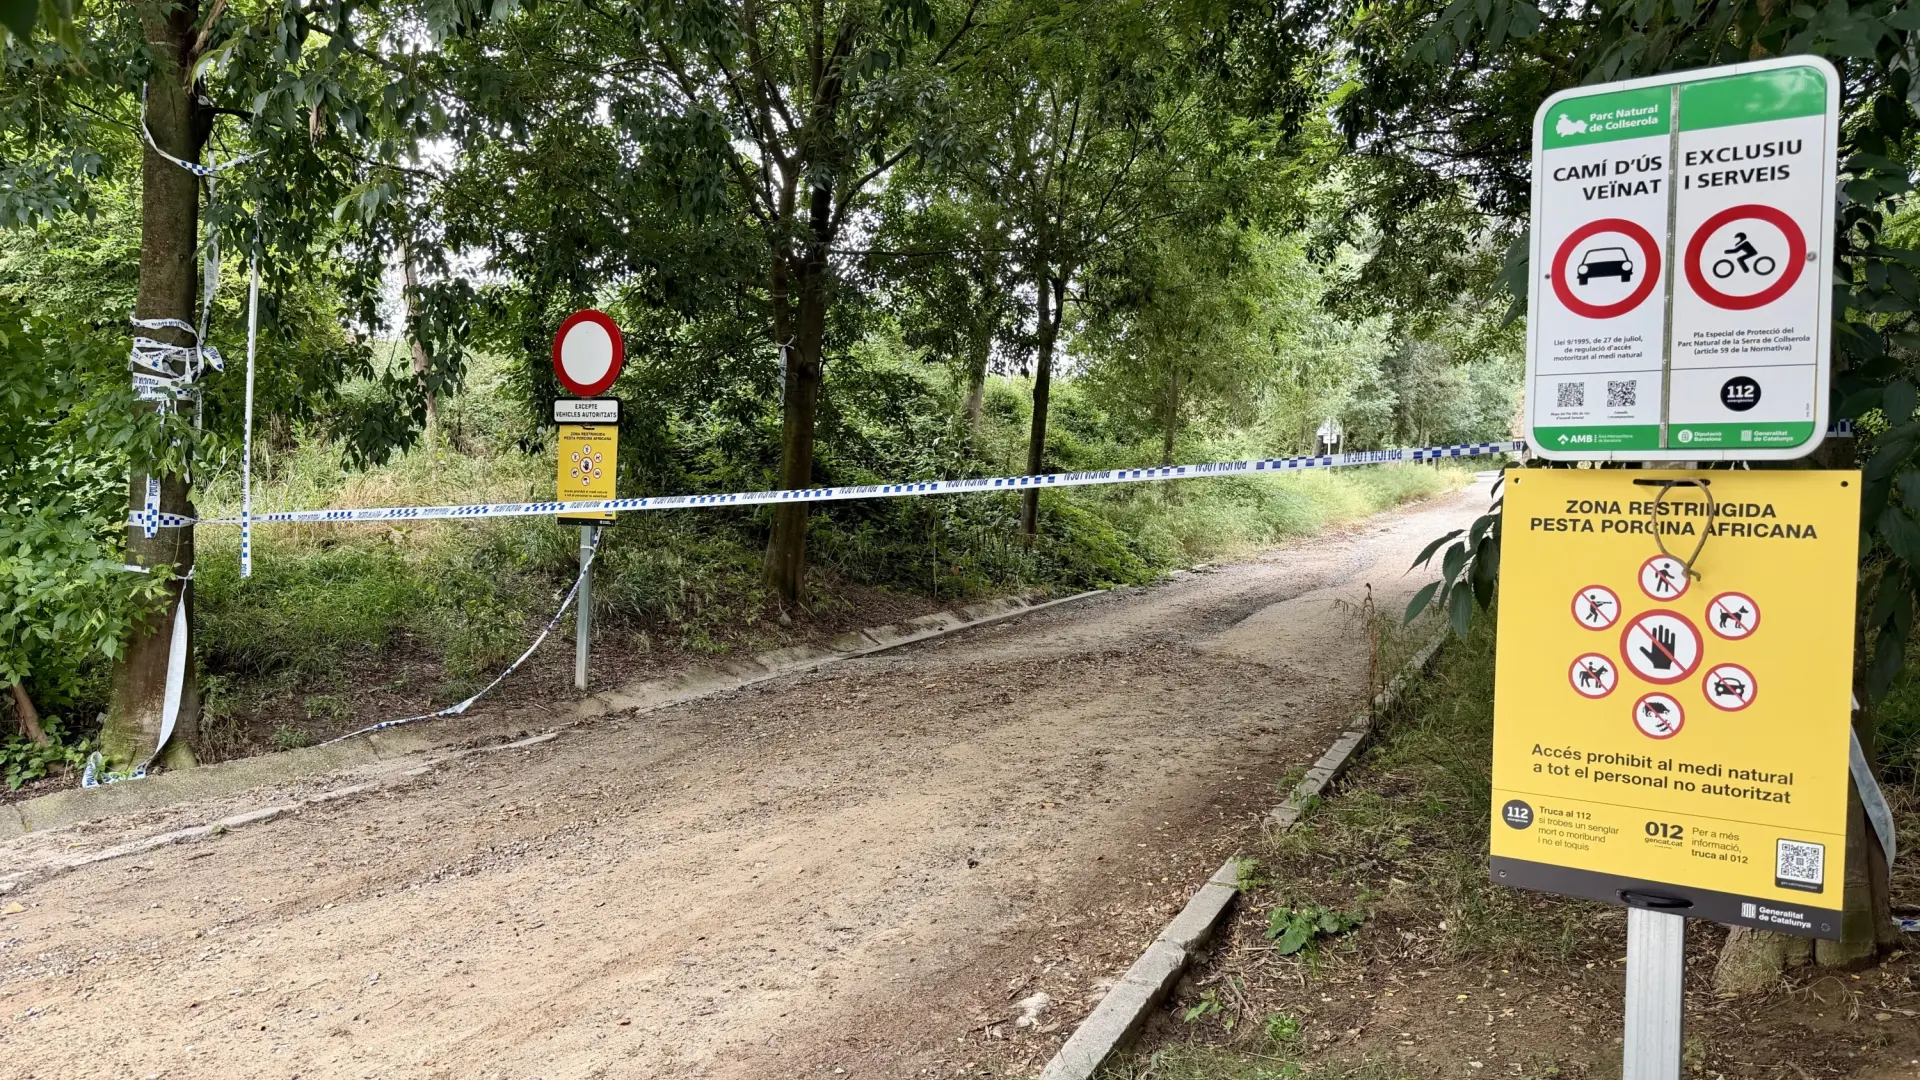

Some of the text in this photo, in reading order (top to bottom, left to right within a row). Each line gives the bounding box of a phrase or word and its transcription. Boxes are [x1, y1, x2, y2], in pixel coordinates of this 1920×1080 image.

[1590, 104, 1658, 121] Parc Natural
[1589, 116, 1658, 132] de Collserola
[1553, 139, 1802, 181] CAMÍ D'ÚS EXCLUSIU
[1583, 164, 1790, 200] VEÏNAT I SERVEIS
[1622, 335, 1643, 343] juliol,
[1706, 330, 1734, 339] Especial
[1747, 328, 1780, 336] Protecció
[1774, 335, 1810, 343] Collserola
[1574, 345, 1605, 353] regulació
[1750, 344, 1792, 353] Normativa)
[1727, 385, 1754, 399] 112
[1570, 434, 1593, 443] AMB
[1565, 499, 1776, 518] ZONA RESTRINGIDA
[1530, 518, 1818, 539] PESTA PORCINA AFRICANA
[1531, 743, 1794, 786] Accés prohibit al medi natural
[1532, 762, 1791, 804] a tot el personal no autoritzat
[1507, 806, 1529, 819] 112
[1539, 806, 1591, 820] Truca al 112
[1547, 818, 1573, 828] trobes
[1588, 823, 1619, 835] senglar
[1645, 821, 1684, 840] 012
[1538, 827, 1557, 836] mort
[1566, 831, 1606, 843] moribund
[1692, 827, 1708, 837] Per
[1719, 832, 1740, 841] més
[1542, 838, 1553, 846] no
[1554, 839, 1562, 847] el
[1564, 841, 1590, 851] toquis
[1644, 837, 1683, 847] gencat.cat
[1691, 838, 1742, 853] informació,
[1691, 849, 1749, 864] truca al 012
[1759, 906, 1804, 920] Generalitat
[1771, 915, 1812, 929] Catalunya
